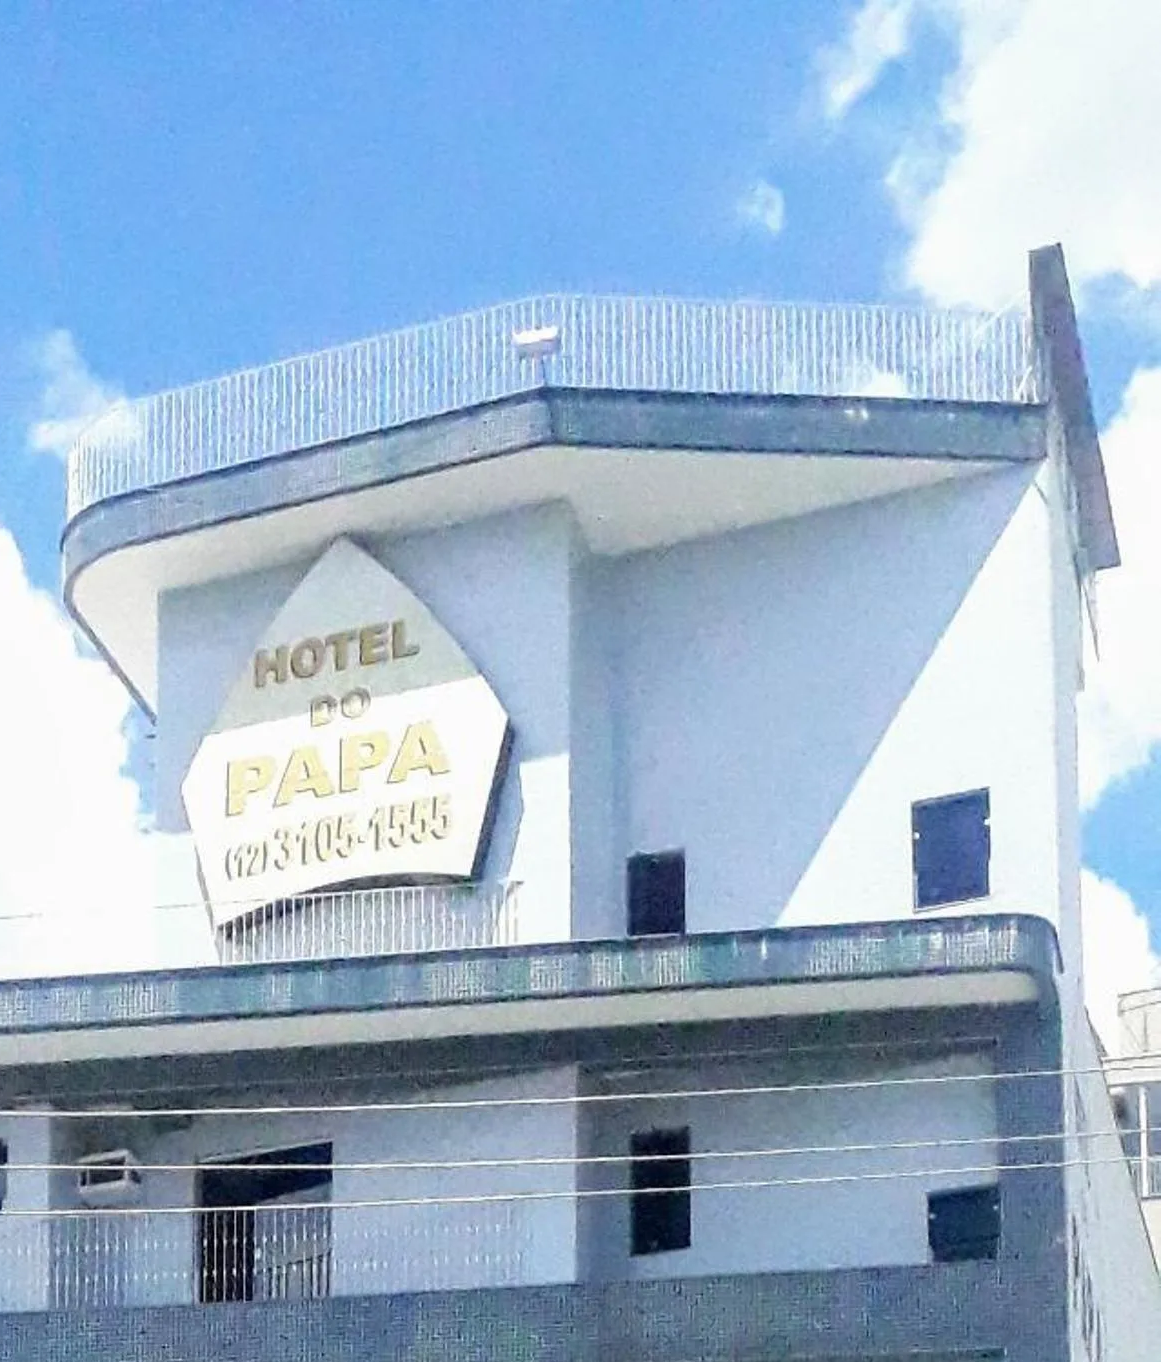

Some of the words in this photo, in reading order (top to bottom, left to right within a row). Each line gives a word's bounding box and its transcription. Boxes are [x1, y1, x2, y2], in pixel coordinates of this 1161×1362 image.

[253, 618, 420, 688] HOTEL
[309, 686, 371, 728] DO
[225, 719, 451, 818] PAPA
